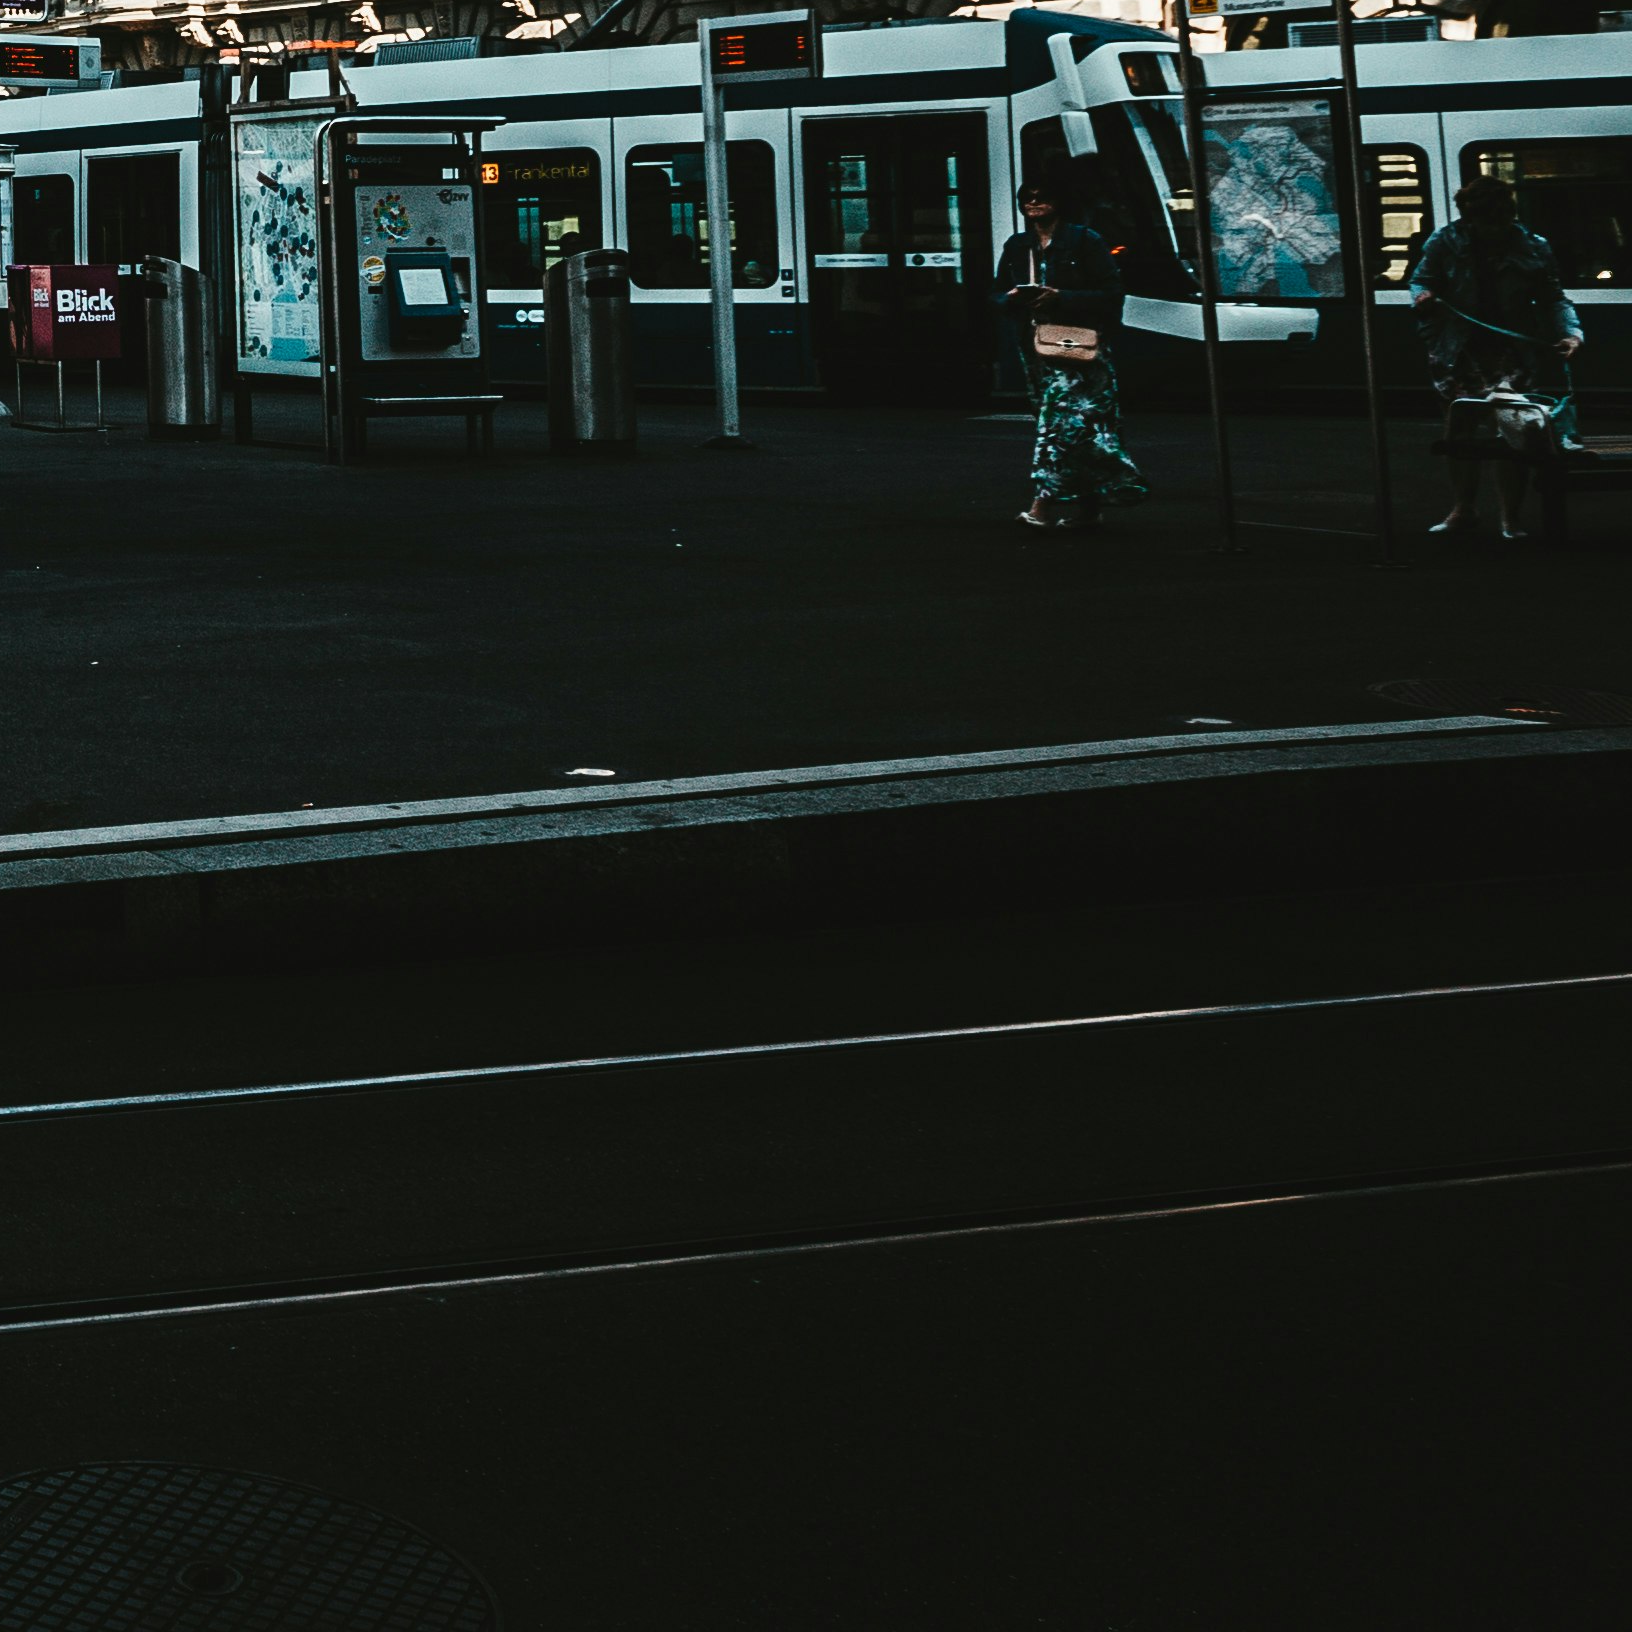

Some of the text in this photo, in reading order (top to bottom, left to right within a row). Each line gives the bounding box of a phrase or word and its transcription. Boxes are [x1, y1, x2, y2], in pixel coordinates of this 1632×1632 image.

[505, 161, 590, 181] Frankental
[56, 288, 115, 312] Blick
[58, 311, 116, 323] am Abend
